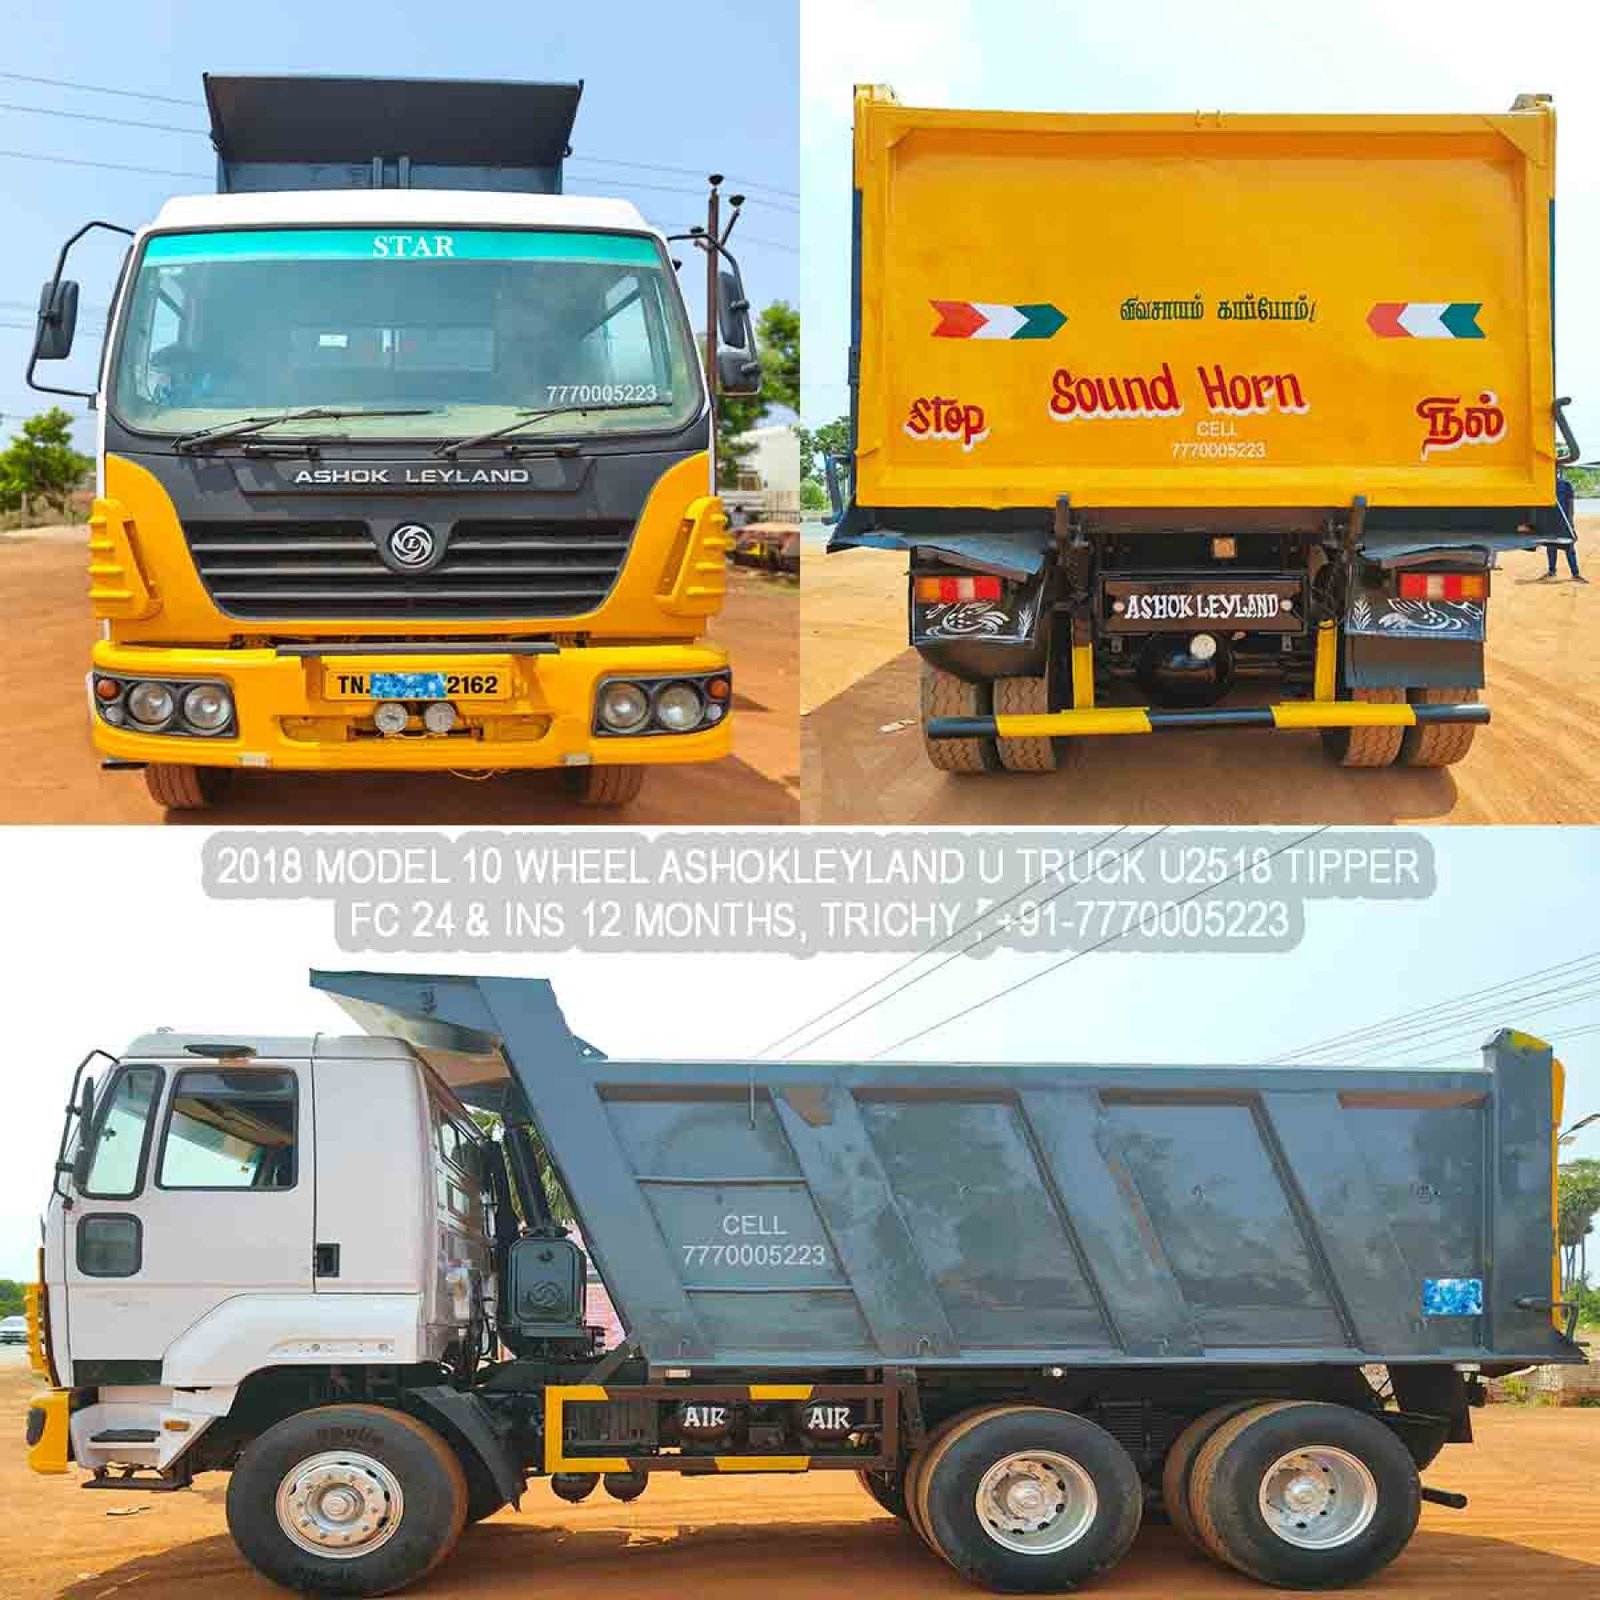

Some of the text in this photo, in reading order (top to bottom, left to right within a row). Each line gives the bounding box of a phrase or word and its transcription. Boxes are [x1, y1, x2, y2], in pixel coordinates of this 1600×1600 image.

[372, 234, 455, 257] STAR
[1048, 362, 1309, 421] Sound Horn
[904, 396, 990, 452] Stop
[294, 468, 531, 484] ASHOK LEYLAND
[1124, 594, 1279, 619] ASHOK LEYLAND
[447, 675, 498, 694] 2162
[683, 1406, 726, 1428] AIR
[808, 1407, 853, 1430] AIR
